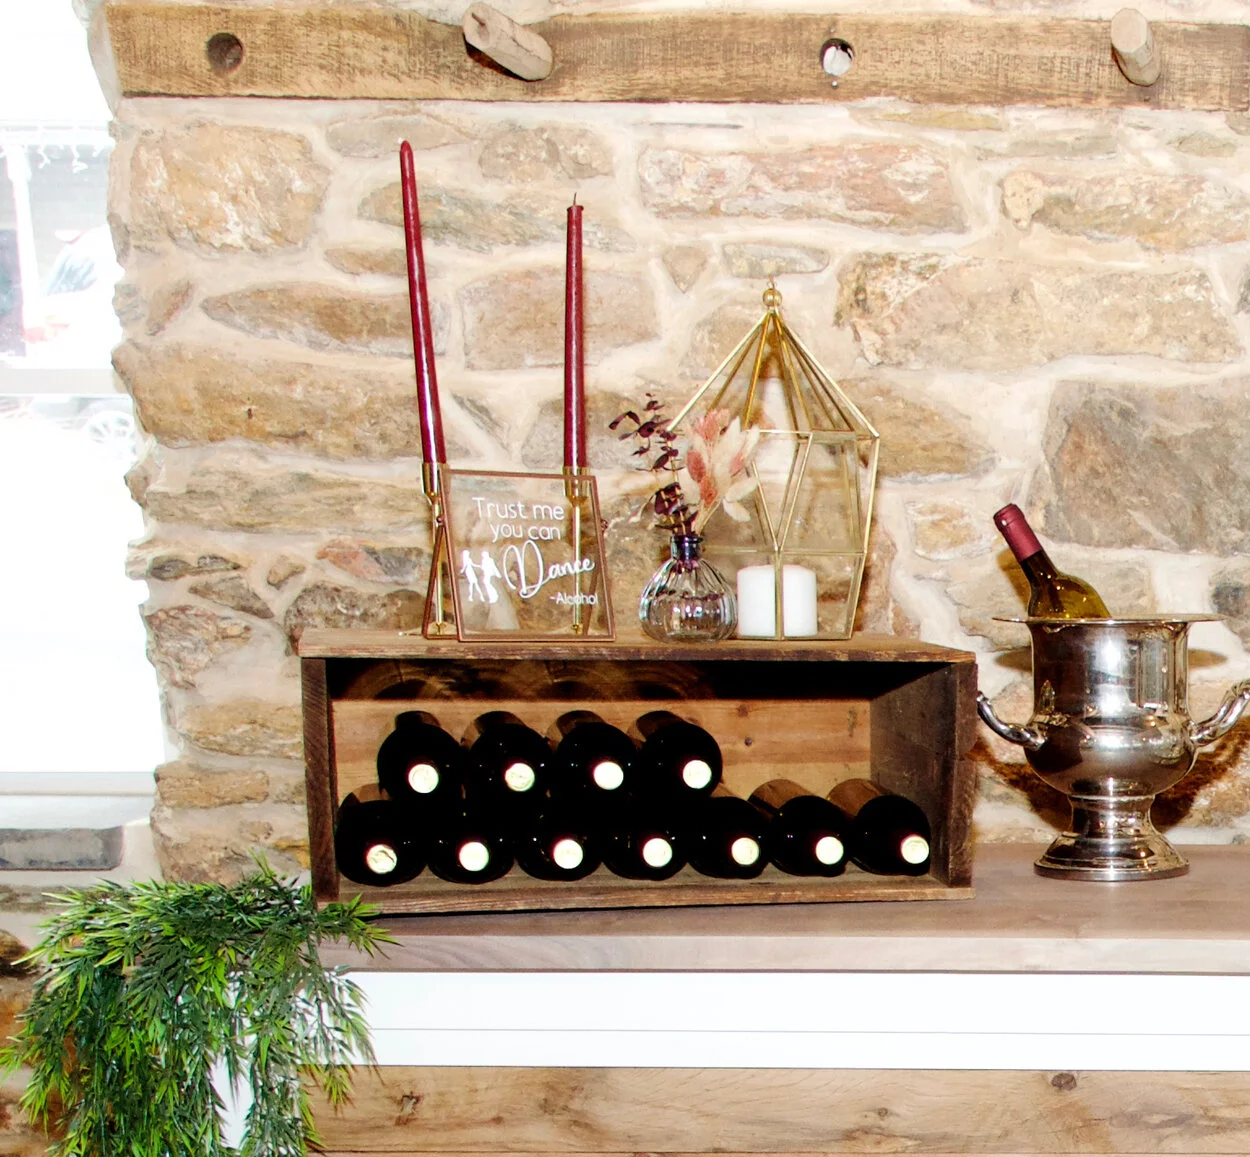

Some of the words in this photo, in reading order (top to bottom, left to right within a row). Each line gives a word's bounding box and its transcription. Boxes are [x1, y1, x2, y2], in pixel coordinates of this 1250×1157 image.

[472, 497, 527, 520] Trust
[532, 503, 565, 520] me
[490, 523, 524, 543] you
[528, 525, 560, 540] can
[503, 540, 595, 598] Dance
